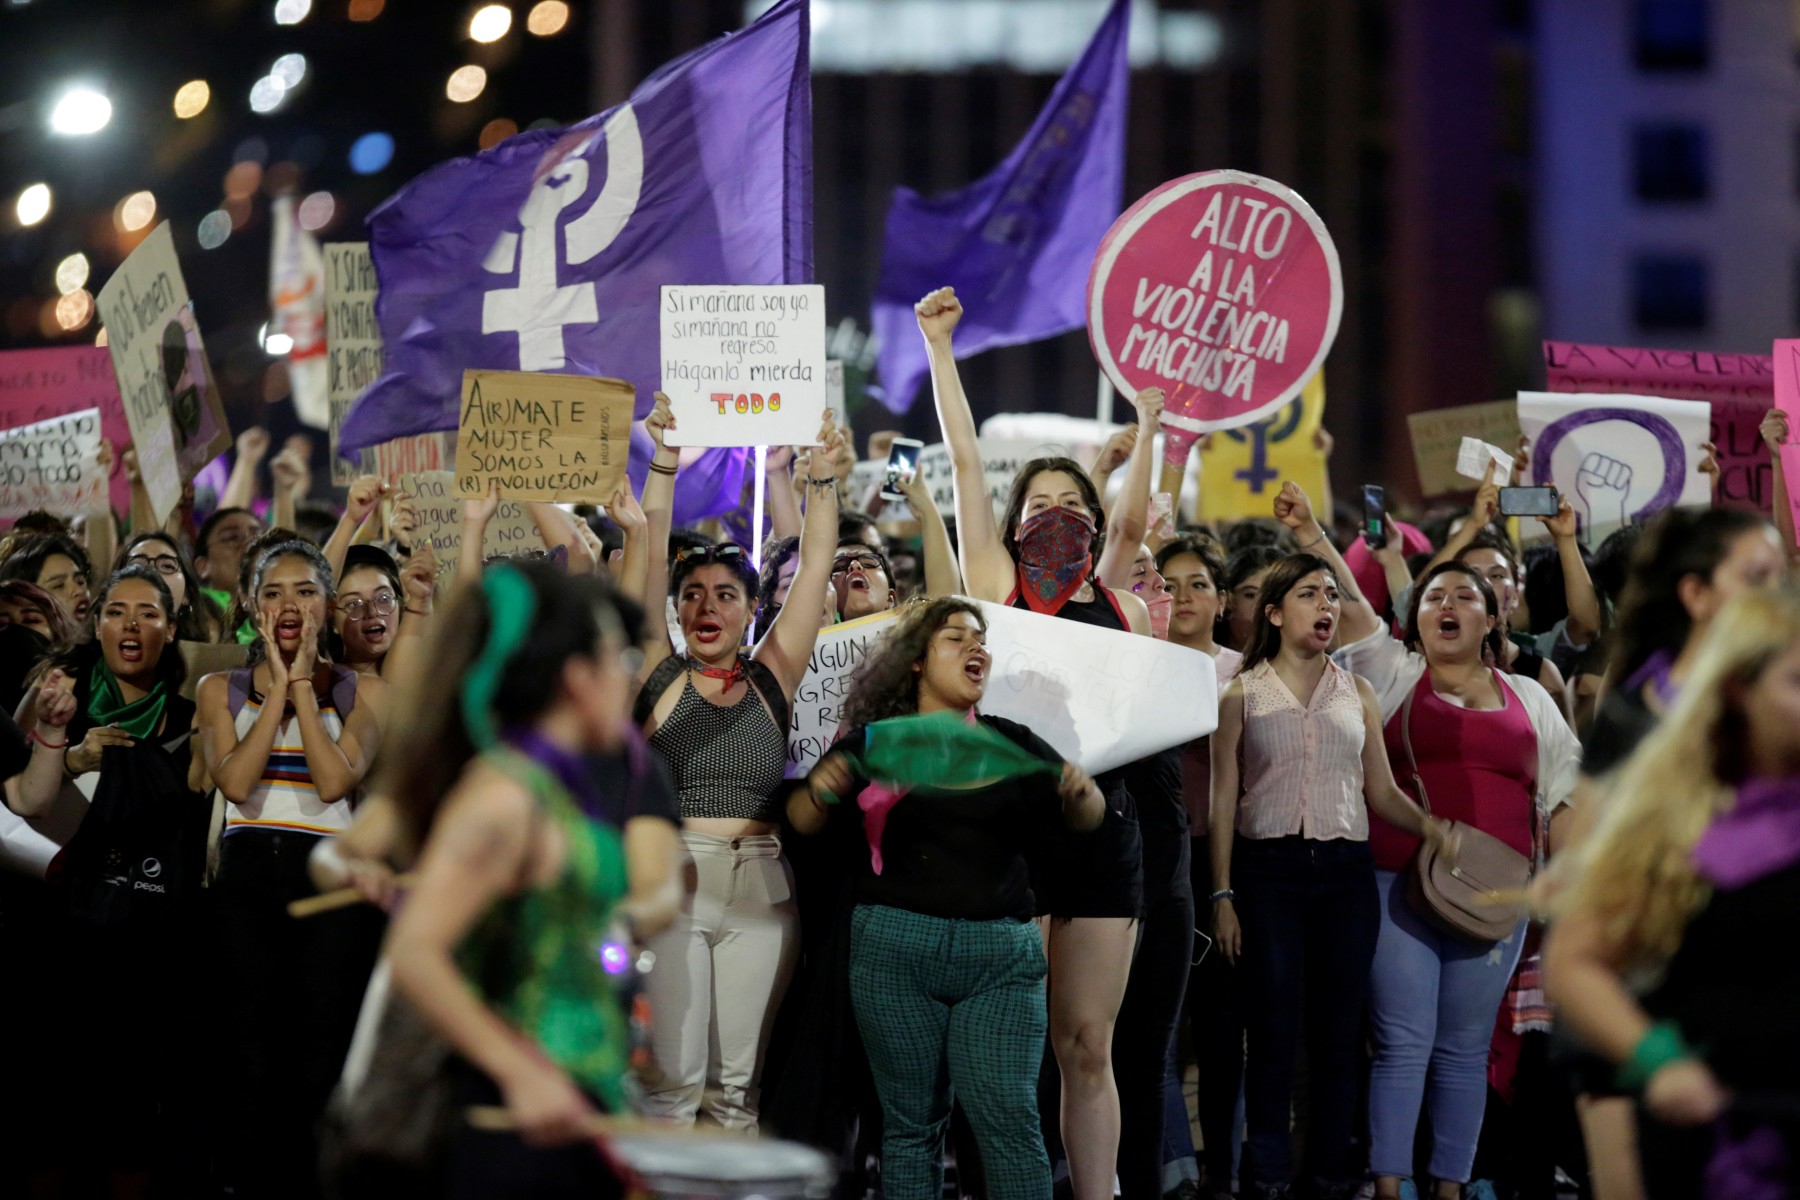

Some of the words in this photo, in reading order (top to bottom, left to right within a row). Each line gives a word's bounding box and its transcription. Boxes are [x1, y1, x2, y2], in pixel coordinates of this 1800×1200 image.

[1191, 191, 1292, 259] ALTO
[1188, 250, 1213, 292] A
[1217, 258, 1255, 306] LA
[666, 289, 684, 313] Si
[689, 290, 755, 313] mañana
[760, 294, 786, 320] soy
[689, 317, 748, 337] mañana
[755, 320, 777, 338] no
[1132, 278, 1290, 364] VIOLENCIA
[1119, 323, 1257, 402] MACHISTA
[1547, 344, 1596, 369] LA
[1606, 347, 1774, 375] VIOLENC
[666, 359, 739, 393] Háganlo
[750, 358, 812, 382] mierda
[710, 392, 781, 415] TODO
[466, 428, 554, 451] MUJER
[471, 450, 543, 472] SOMOS
[559, 450, 586, 467] LA
[401, 475, 445, 499] Una
[498, 526, 525, 542] NO
[796, 673, 851, 704] GRE
[818, 703, 848, 727] RE
[134, 881, 166, 894] pepsi
